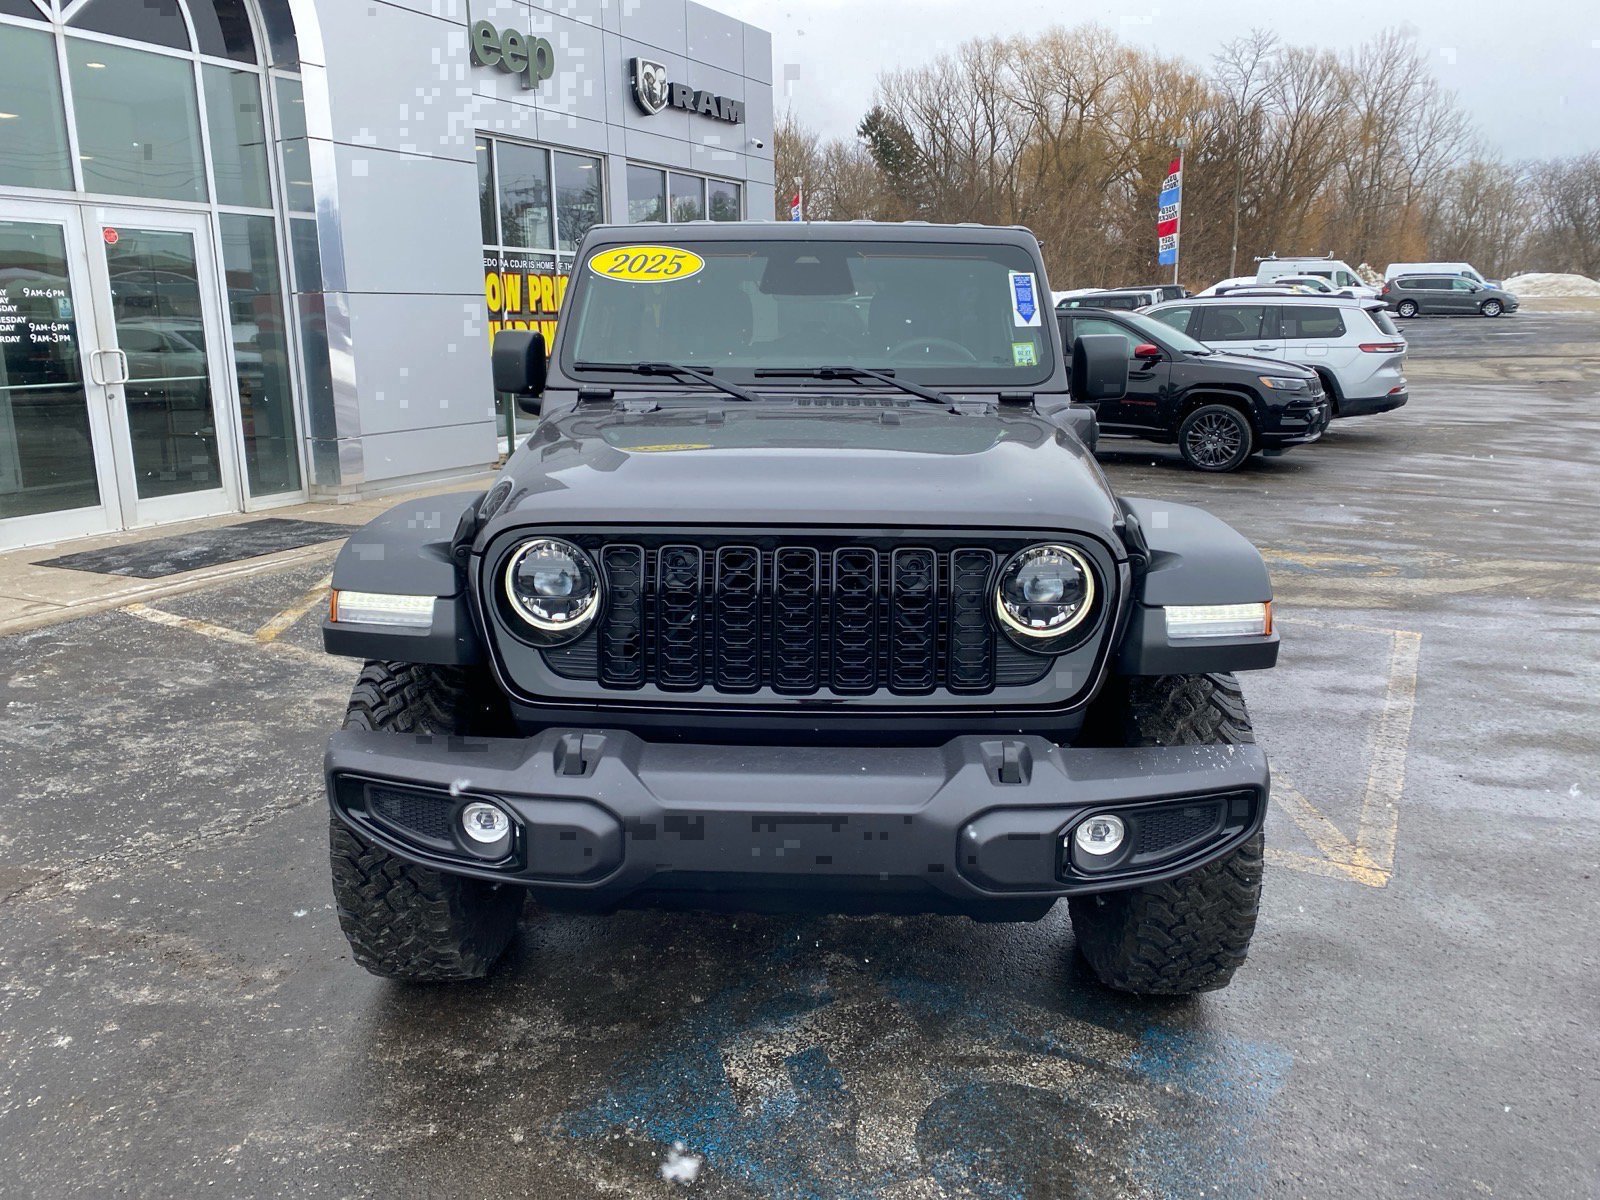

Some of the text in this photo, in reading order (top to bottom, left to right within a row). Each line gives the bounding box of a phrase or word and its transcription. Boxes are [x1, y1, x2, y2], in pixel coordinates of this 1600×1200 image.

[671, 82, 745, 123] RAM
[536, 262, 554, 270] HOME
[607, 254, 687, 275] 2025
[23, 287, 65, 298] 9AM-6PM
[29, 322, 69, 332] 9AM-6PM
[30, 333, 71, 343] 9AM-3PM
